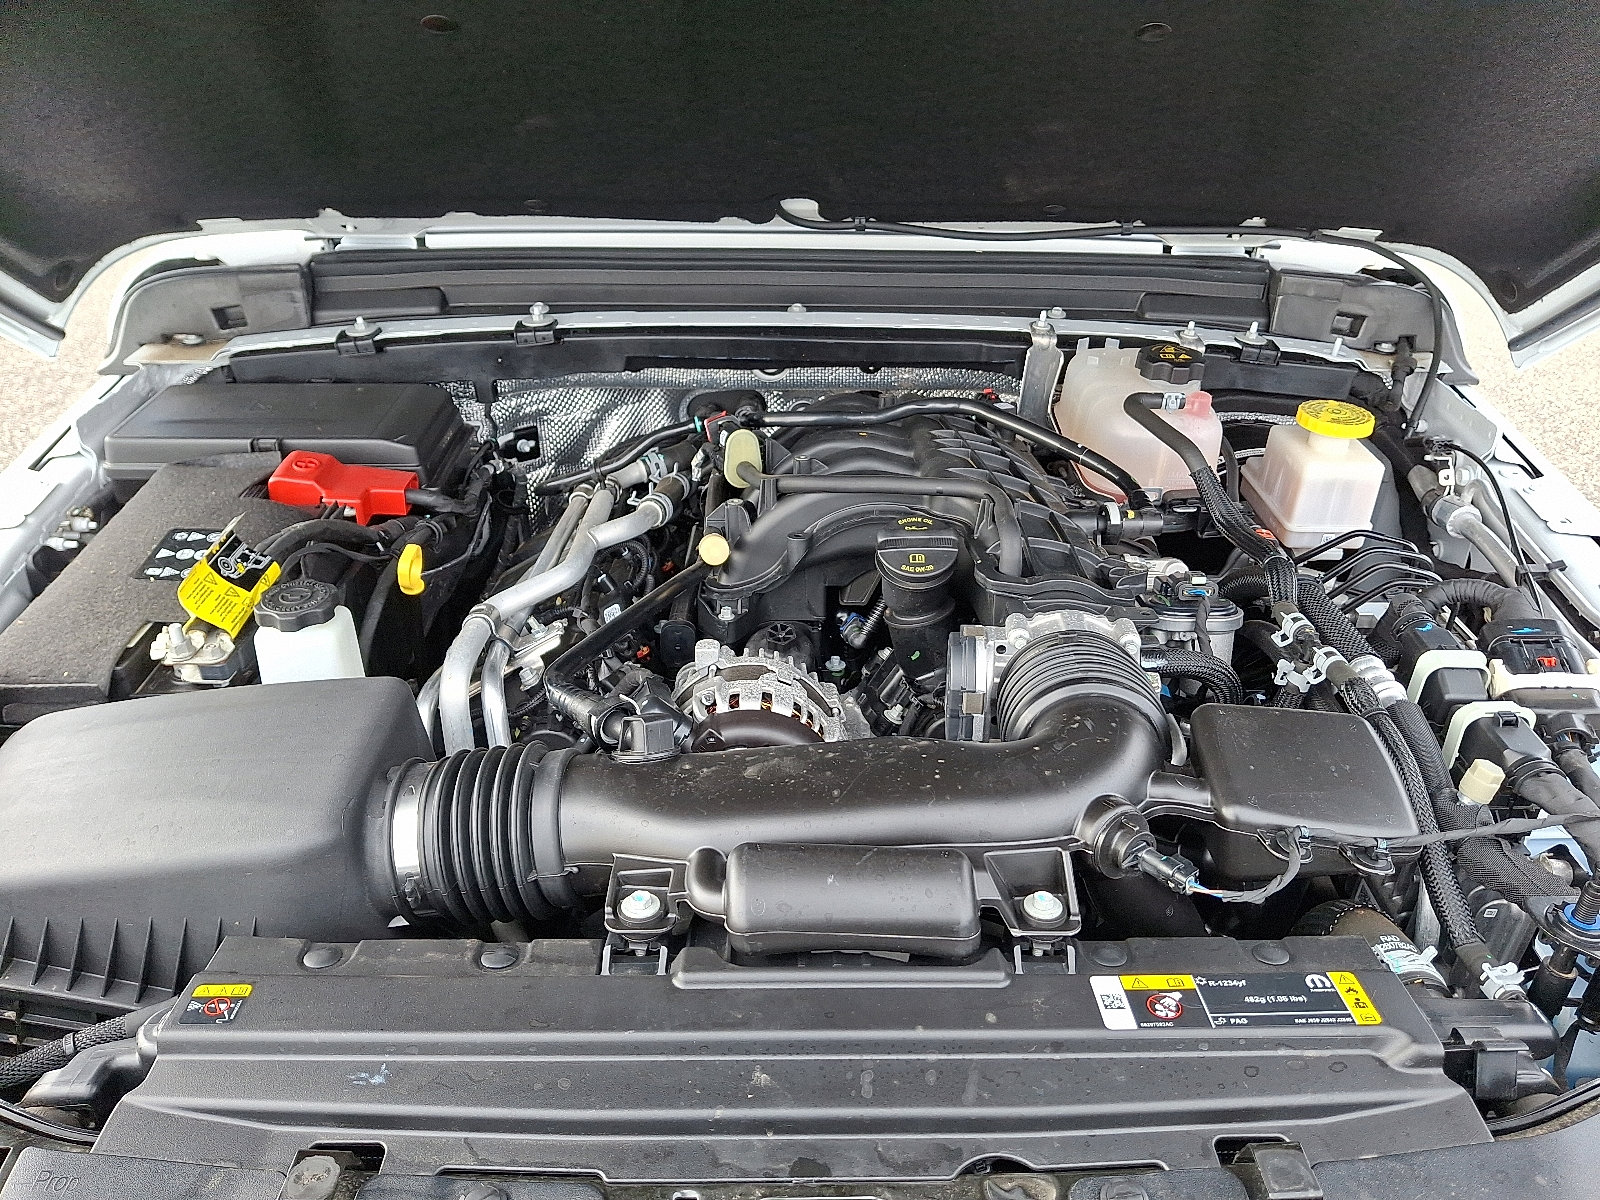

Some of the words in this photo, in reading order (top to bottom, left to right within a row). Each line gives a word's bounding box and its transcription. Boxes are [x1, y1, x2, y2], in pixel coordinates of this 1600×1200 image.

[897, 516, 922, 525] ENGINE
[900, 564, 915, 573] SAE
[1379, 935, 1400, 943] RAD
[1208, 979, 1247, 988] R-1234yf
[1289, 994, 1307, 1003] lbs)
[1230, 1017, 1248, 1025] PAG
